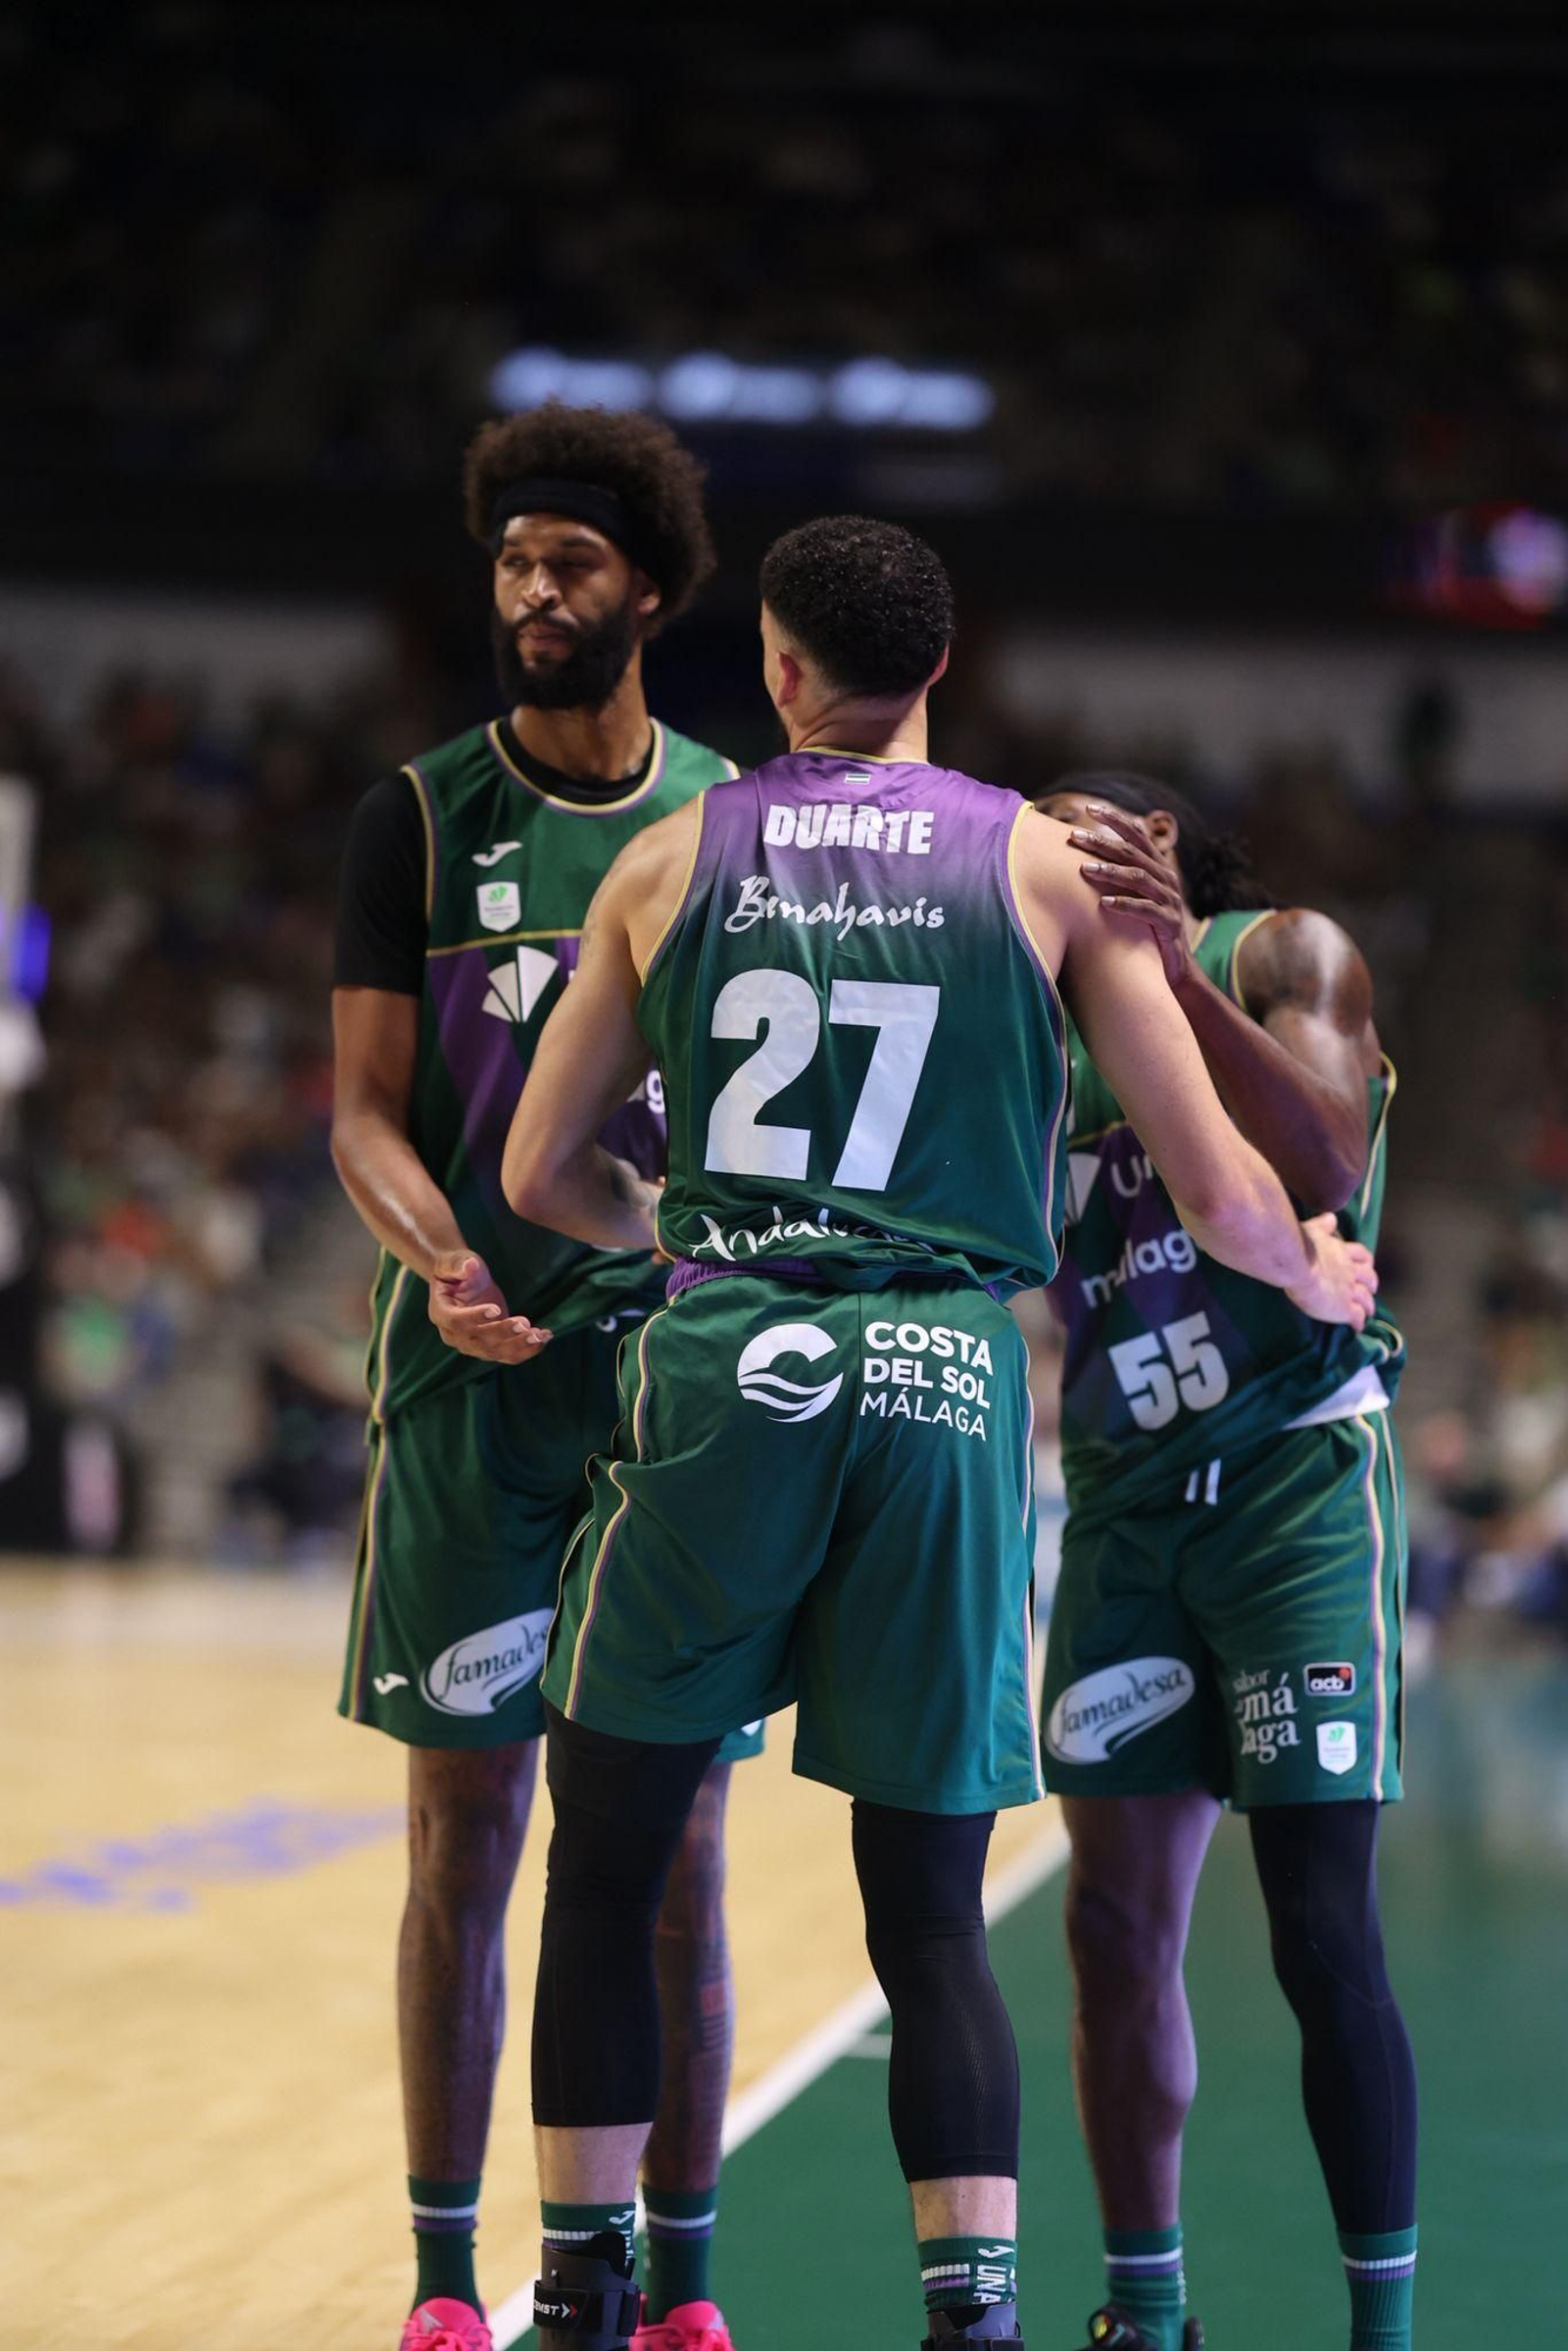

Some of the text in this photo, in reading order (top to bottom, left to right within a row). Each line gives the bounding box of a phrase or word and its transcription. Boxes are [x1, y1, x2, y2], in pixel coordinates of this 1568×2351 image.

[763, 804, 935, 855] DUARTE
[704, 968, 941, 1191] 27
[864, 1321, 994, 1377] COSTA
[1107, 1310, 1230, 1431] 55
[863, 1357, 991, 1409] DEL SOL
[859, 1387, 987, 1442] MÁLAGA
[1055, 1669, 1187, 1748] famadesa
[1310, 1675, 1345, 1691] acb
